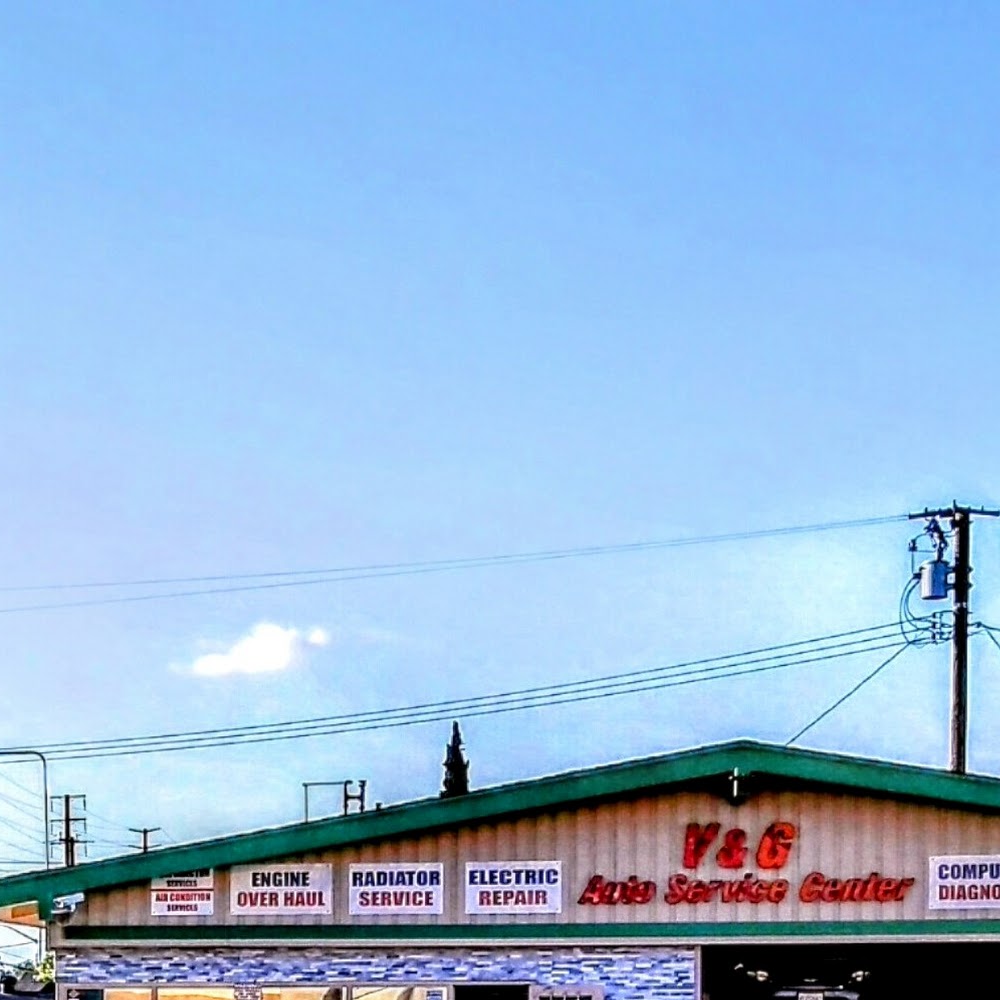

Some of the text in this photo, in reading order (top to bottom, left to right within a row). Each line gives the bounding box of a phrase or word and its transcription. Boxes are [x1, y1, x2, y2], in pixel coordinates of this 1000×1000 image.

[682, 821, 796, 869] V & G
[352, 870, 441, 887] RADIATOR
[468, 869, 559, 886] ELECTRIC
[938, 863, 1000, 880] COMPU
[251, 872, 310, 888] ENGINE
[577, 871, 915, 905] Auto Service Center
[156, 893, 211, 902] AIR CONDITION
[237, 891, 326, 907] OVER HAUL
[358, 891, 434, 907] SERVICE
[478, 890, 548, 906] REPAIR
[167, 903, 198, 912] SERVICES
